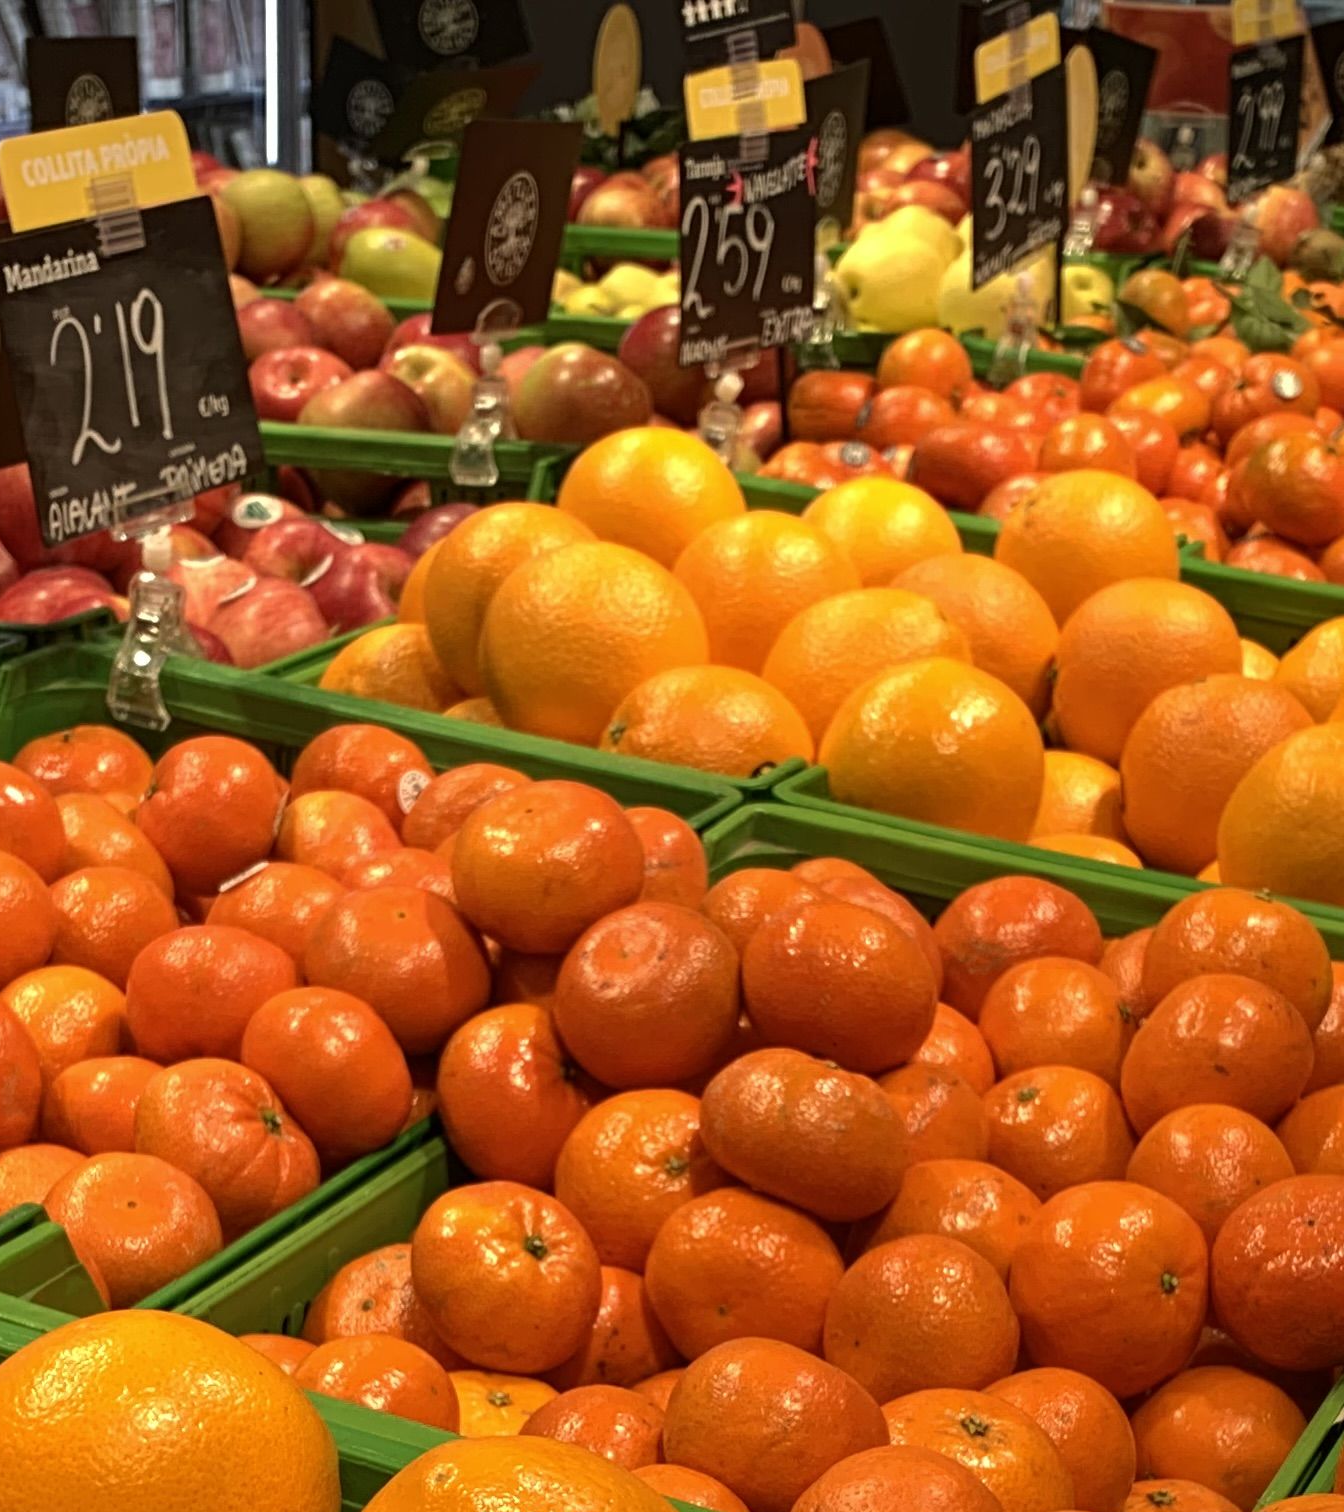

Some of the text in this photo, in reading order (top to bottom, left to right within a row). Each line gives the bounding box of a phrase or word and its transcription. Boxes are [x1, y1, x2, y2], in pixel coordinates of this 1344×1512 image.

[21, 133, 171, 188] COLLITA PRÒPIA
[3, 249, 100, 293] Mandarina
